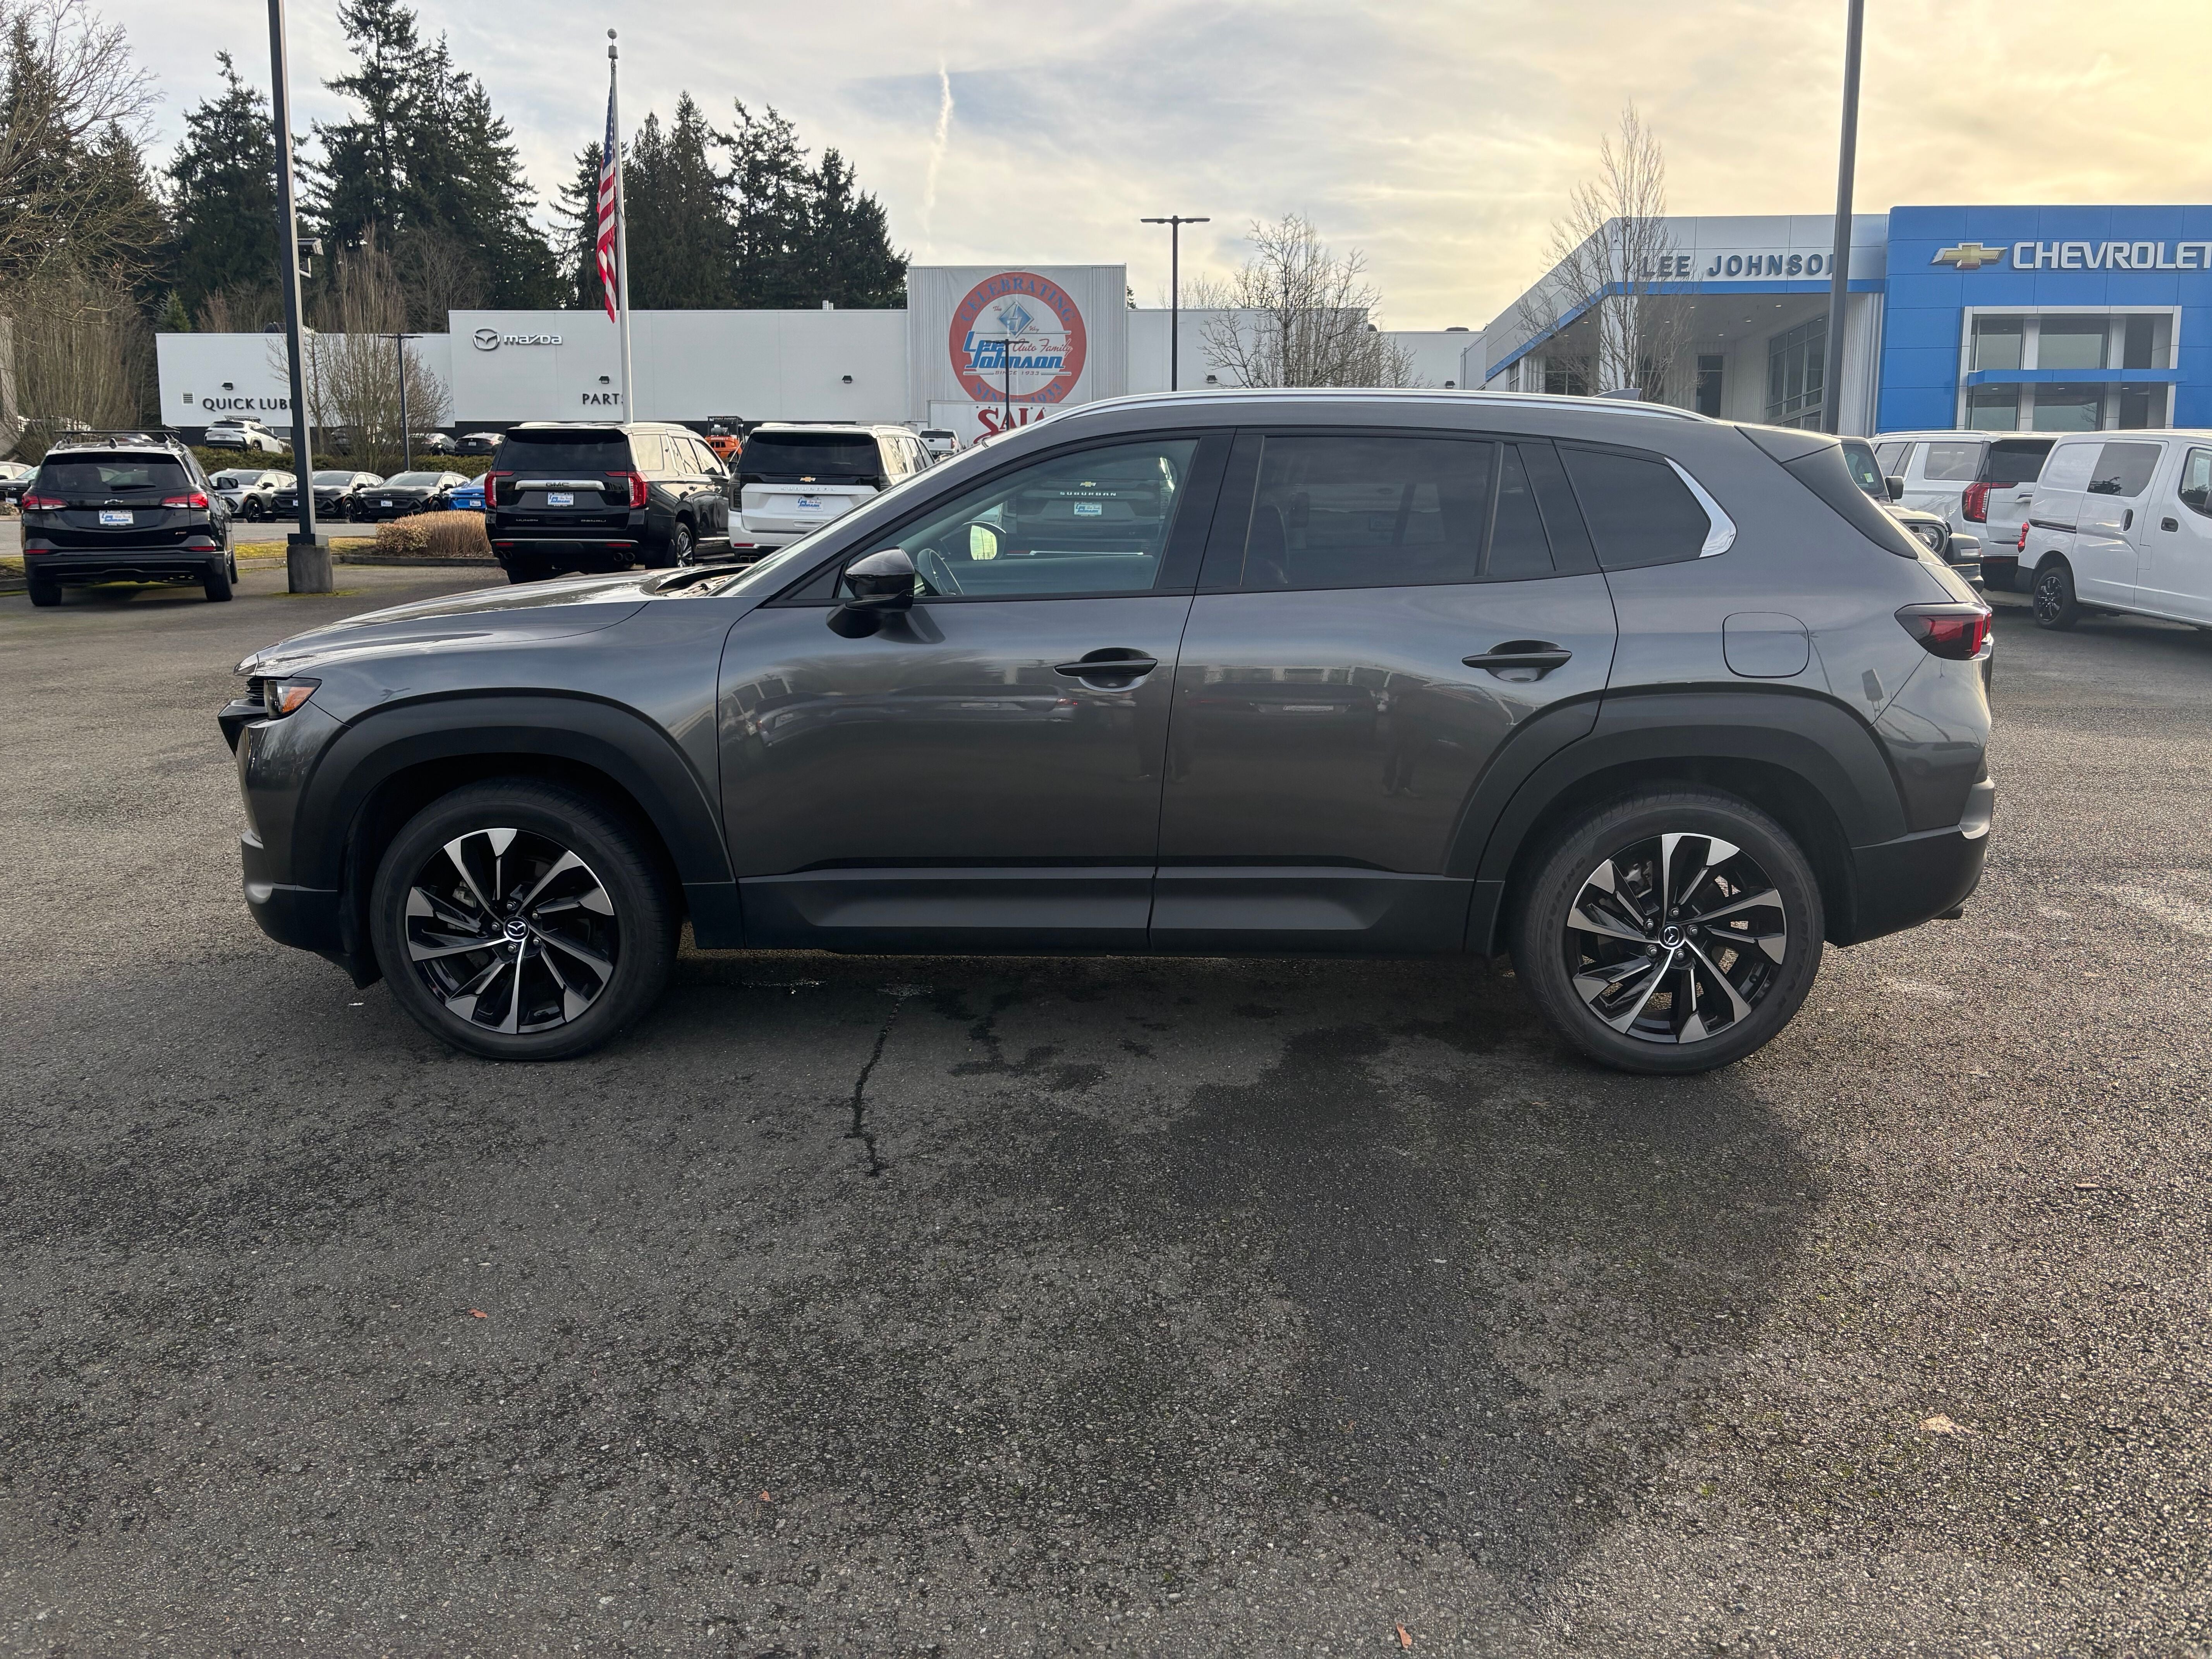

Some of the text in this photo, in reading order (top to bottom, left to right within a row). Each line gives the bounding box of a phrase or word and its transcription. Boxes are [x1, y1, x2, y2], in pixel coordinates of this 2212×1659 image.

[1642, 256, 1690, 276] LEE
[2014, 242, 2212, 268] CHEVROLET
[960, 276, 1075, 321] CELEBRATING
[504, 335, 563, 345] mazda
[963, 331, 1073, 357] Lee Auto Family
[965, 345, 1065, 369] Johnson
[203, 398, 291, 412] QUICK LUB
[582, 393, 623, 405] PART
